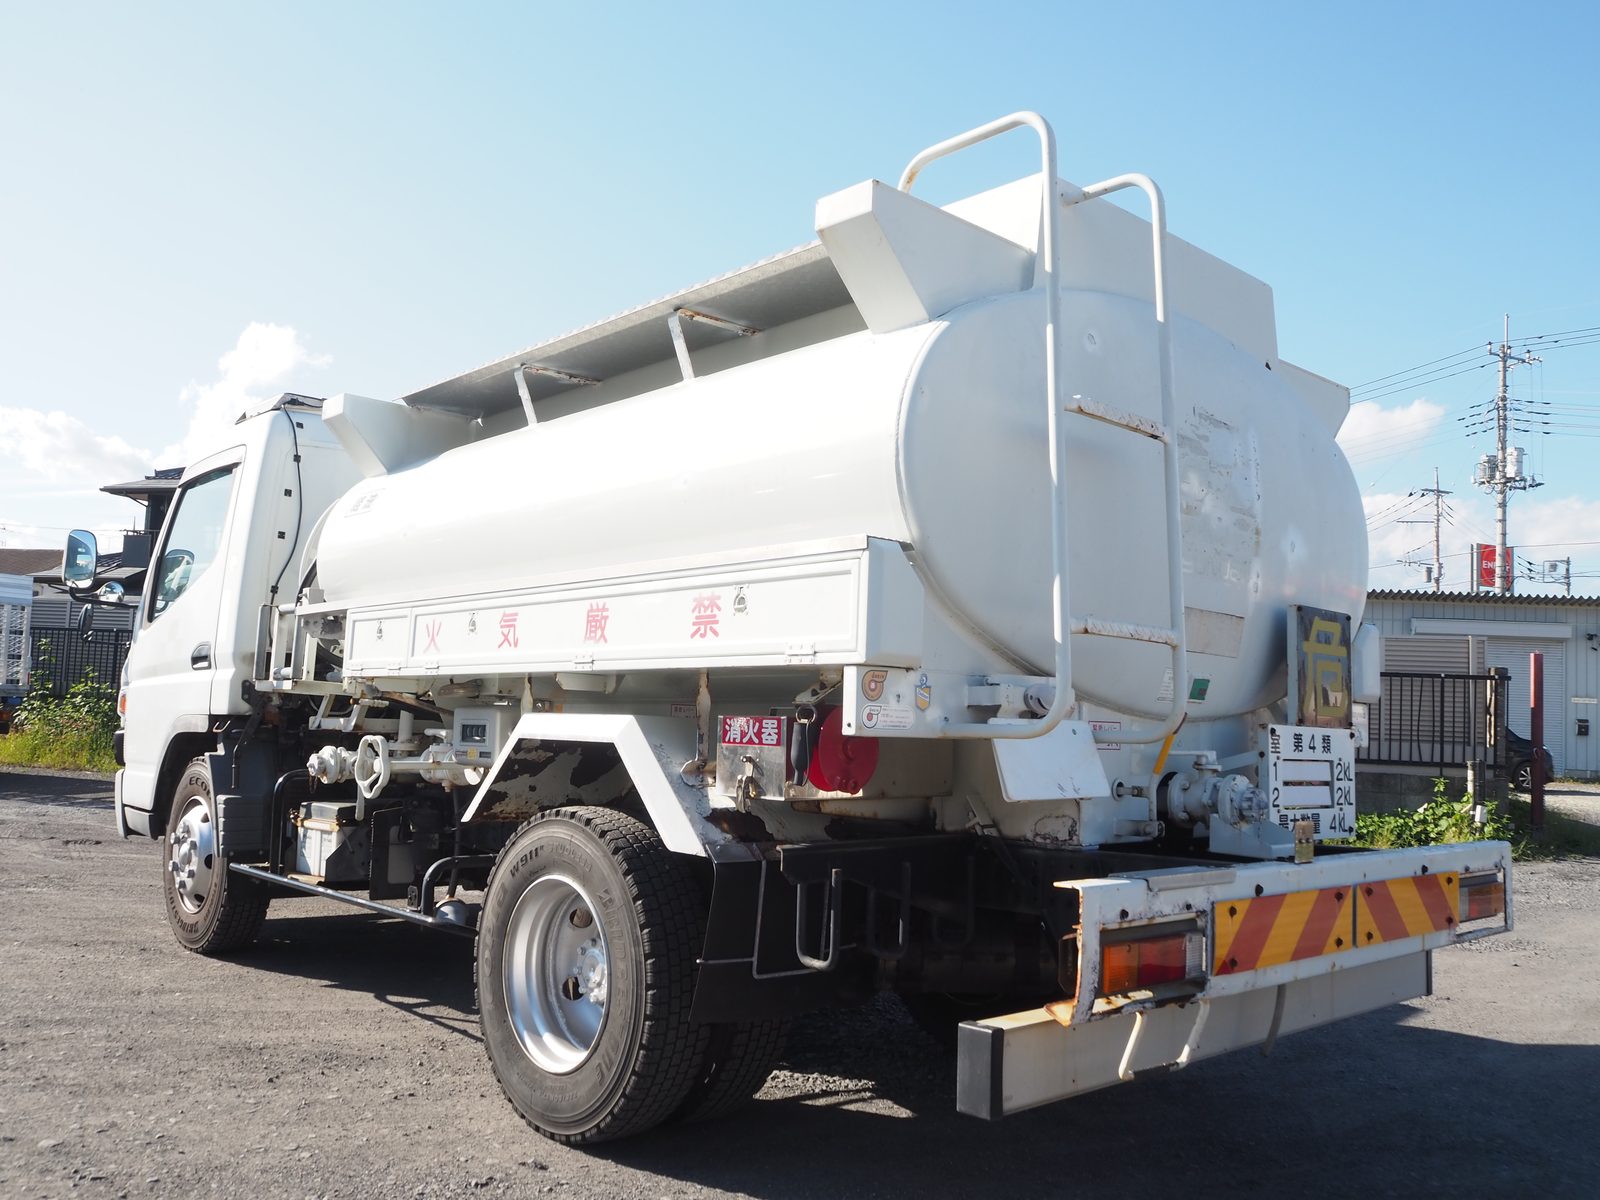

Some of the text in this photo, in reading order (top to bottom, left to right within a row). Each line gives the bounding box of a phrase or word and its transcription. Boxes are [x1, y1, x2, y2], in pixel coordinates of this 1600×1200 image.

[1482, 559, 1512, 572] ENS
[421, 592, 722, 654] 火気厳禁
[1303, 616, 1347, 718] 危
[725, 718, 778, 744] 消火器
[1272, 761, 1278, 781] 1
[1272, 787, 1280, 808] 2
